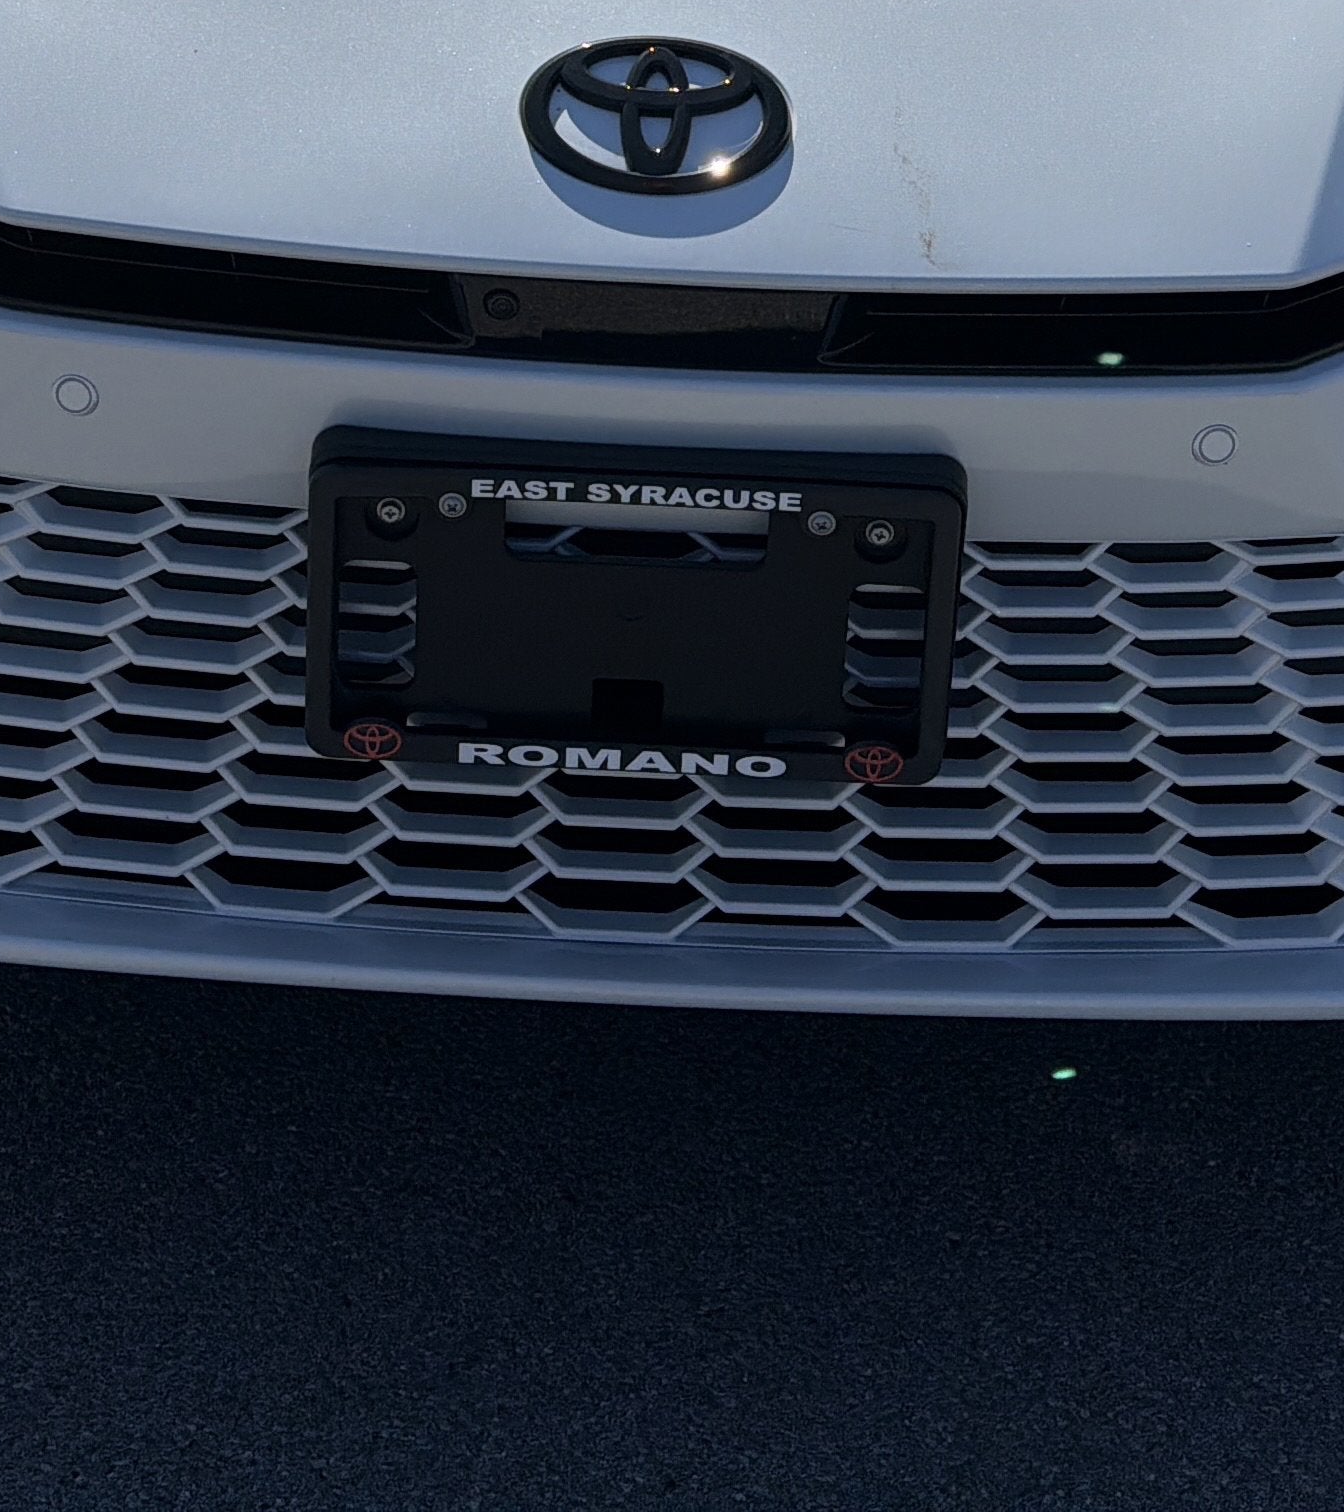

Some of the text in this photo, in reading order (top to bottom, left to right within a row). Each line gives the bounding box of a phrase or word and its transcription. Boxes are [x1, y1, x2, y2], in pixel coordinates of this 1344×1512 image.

[471, 479, 802, 512] EAST SYRACUSE
[458, 742, 787, 778] ROMANO
